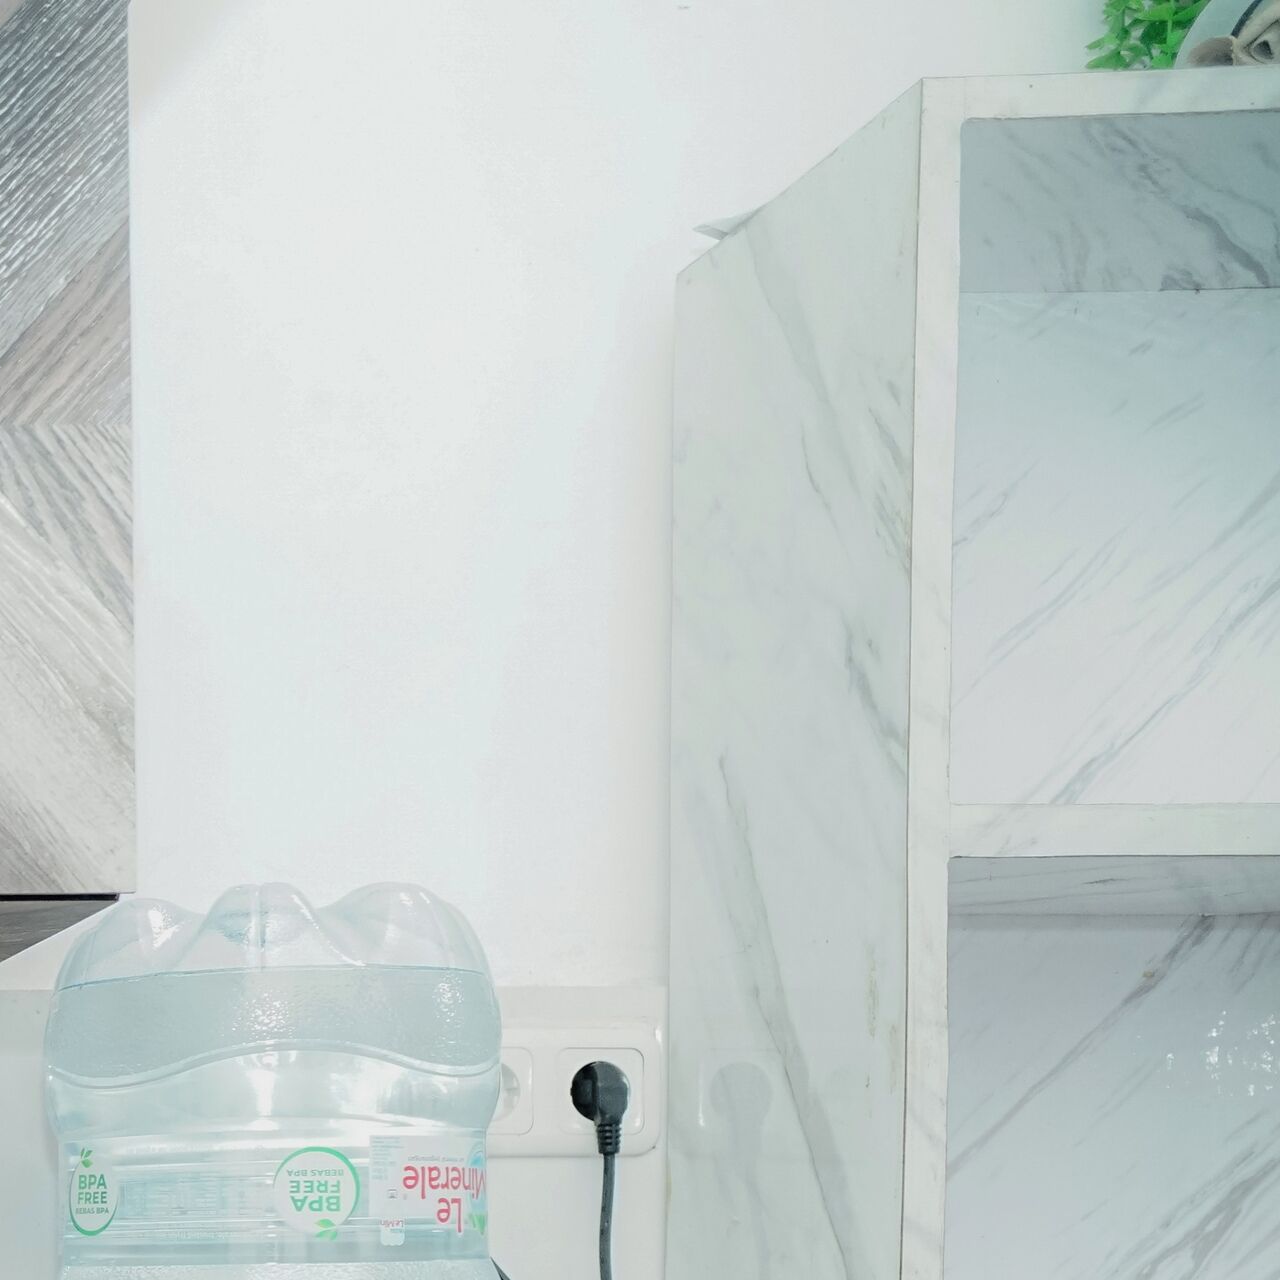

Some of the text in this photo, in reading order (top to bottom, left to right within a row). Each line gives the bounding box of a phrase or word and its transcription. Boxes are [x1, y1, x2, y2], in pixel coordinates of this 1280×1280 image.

[311, 1168, 344, 1176] BEBAS
[78, 1173, 107, 1190] BPA
[289, 1180, 341, 1193] FREE
[402, 1165, 486, 1200] Minerale
[77, 1191, 108, 1204] FREE
[290, 1195, 341, 1212] BPA
[436, 1197, 462, 1233] Le
